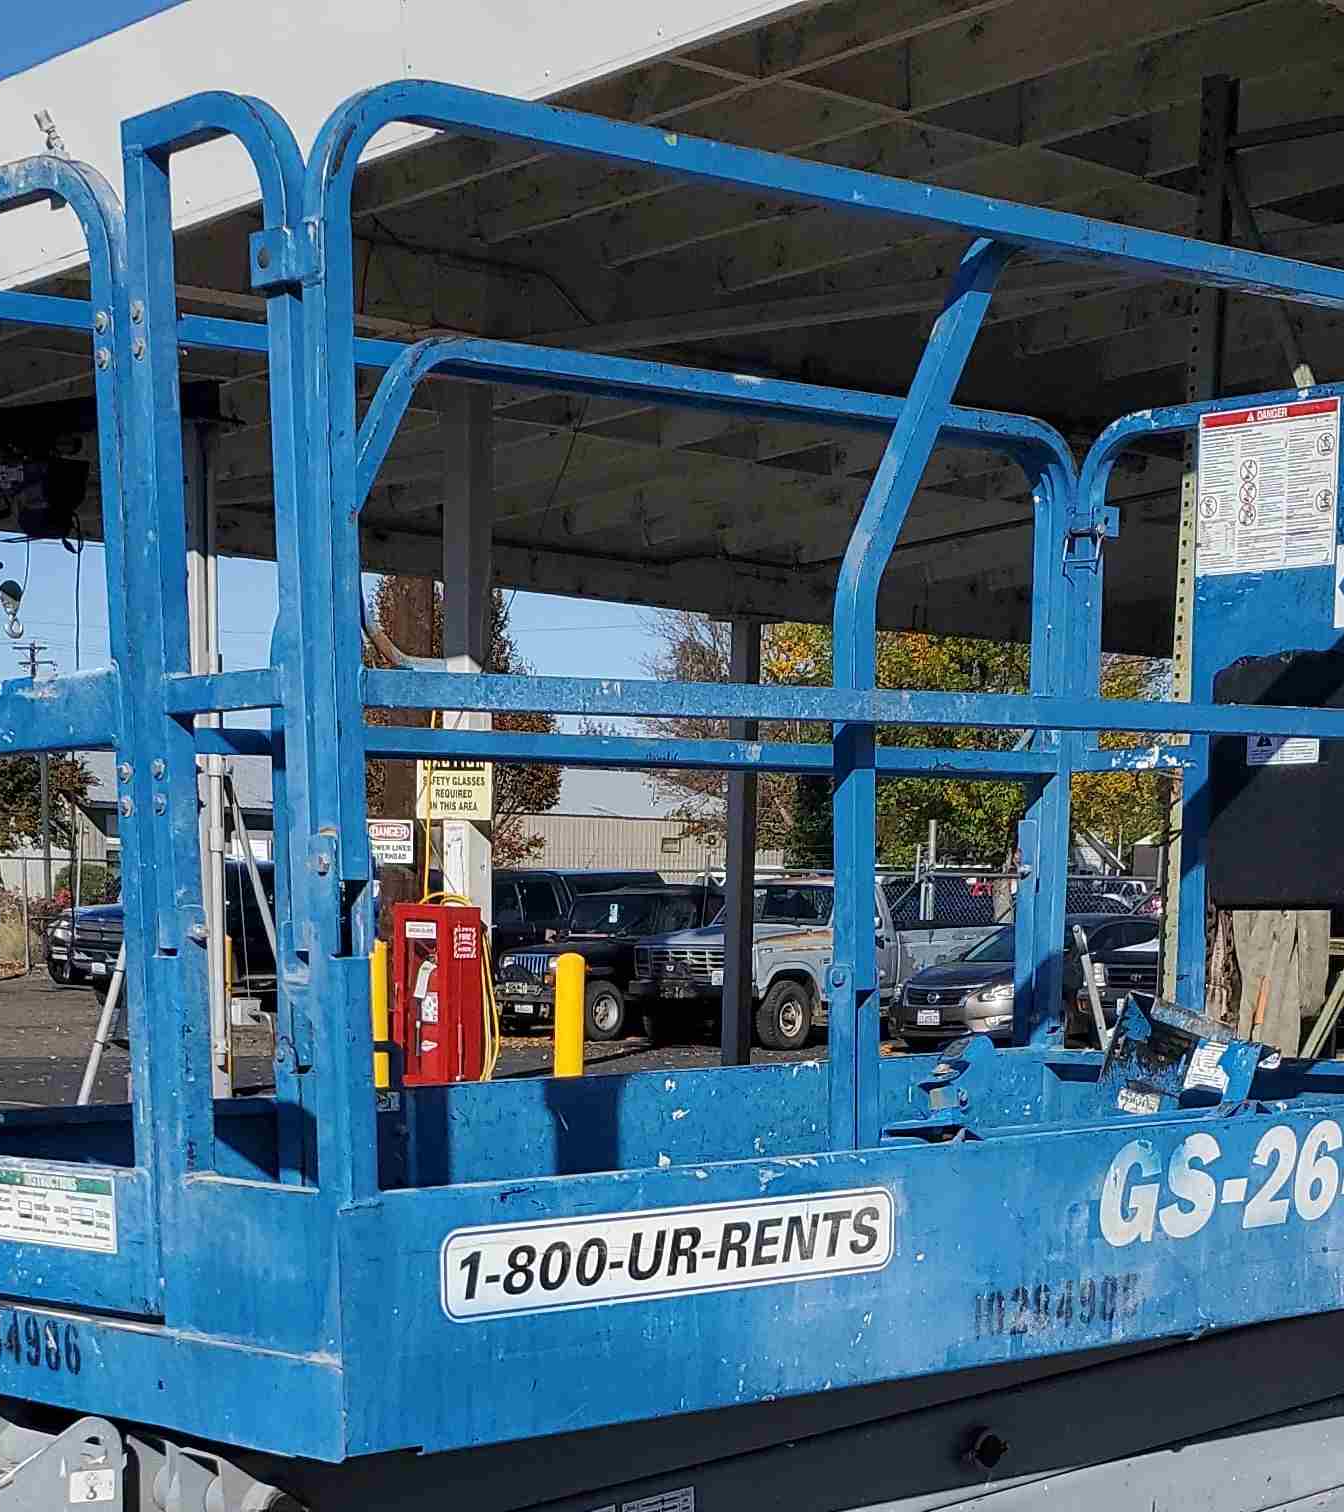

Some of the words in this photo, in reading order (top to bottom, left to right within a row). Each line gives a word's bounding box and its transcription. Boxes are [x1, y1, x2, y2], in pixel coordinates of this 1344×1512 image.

[1257, 408, 1288, 421] DANGER
[423, 776, 450, 786] SFETY
[452, 776, 486, 786] GLASSES
[436, 788, 473, 799] REQUIRED
[440, 802, 457, 811] THIS
[458, 802, 479, 811] AREA
[457, 1205, 880, 1300] 1-800-UR-RENTS
